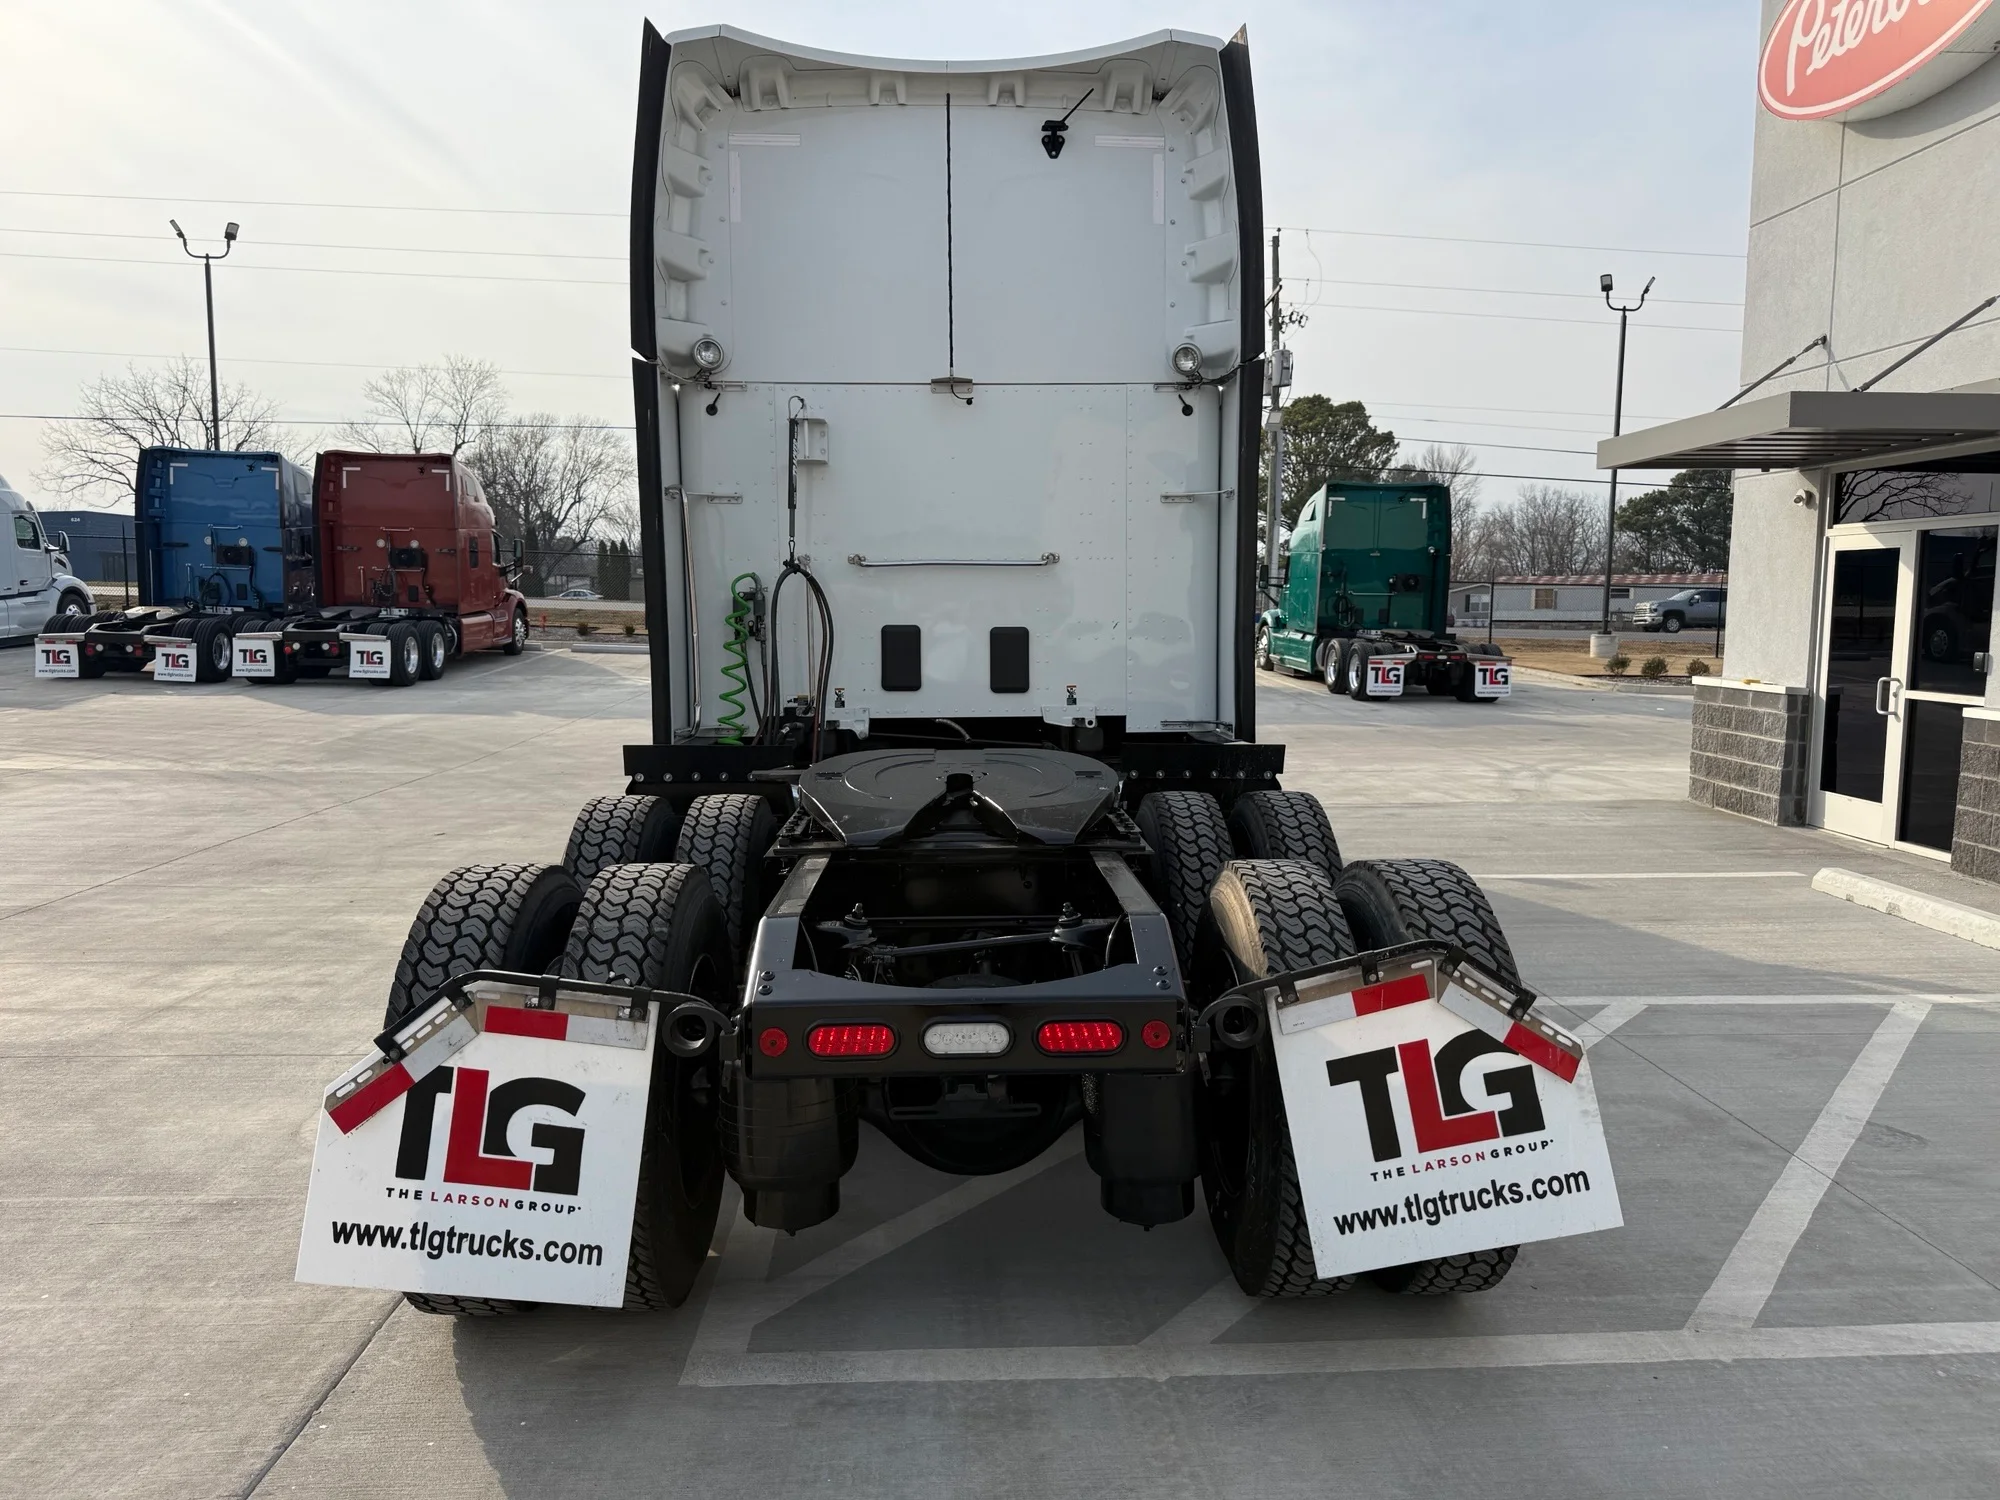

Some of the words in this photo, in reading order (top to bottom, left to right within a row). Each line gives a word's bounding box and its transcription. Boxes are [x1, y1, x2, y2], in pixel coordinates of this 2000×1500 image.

[41, 649, 71, 664] TLG
[161, 653, 189, 668] TLG
[238, 648, 267, 663] TLG
[356, 650, 383, 665] TLG
[1370, 667, 1401, 684] TLG
[1478, 668, 1509, 685] TLG
[1326, 1029, 1546, 1163] TLG
[395, 1065, 586, 1196] TLG
[1370, 1167, 1406, 1182] THE
[1412, 1151, 1486, 1174] LARSON
[1490, 1140, 1549, 1159] GROUP
[385, 1187, 423, 1201] THE
[430, 1191, 509, 1208] LARSON
[514, 1200, 576, 1215] GROUP
[1333, 1169, 1591, 1236] www.tlgtrucks.com
[331, 1221, 603, 1266] www.tlgtrucks.com
